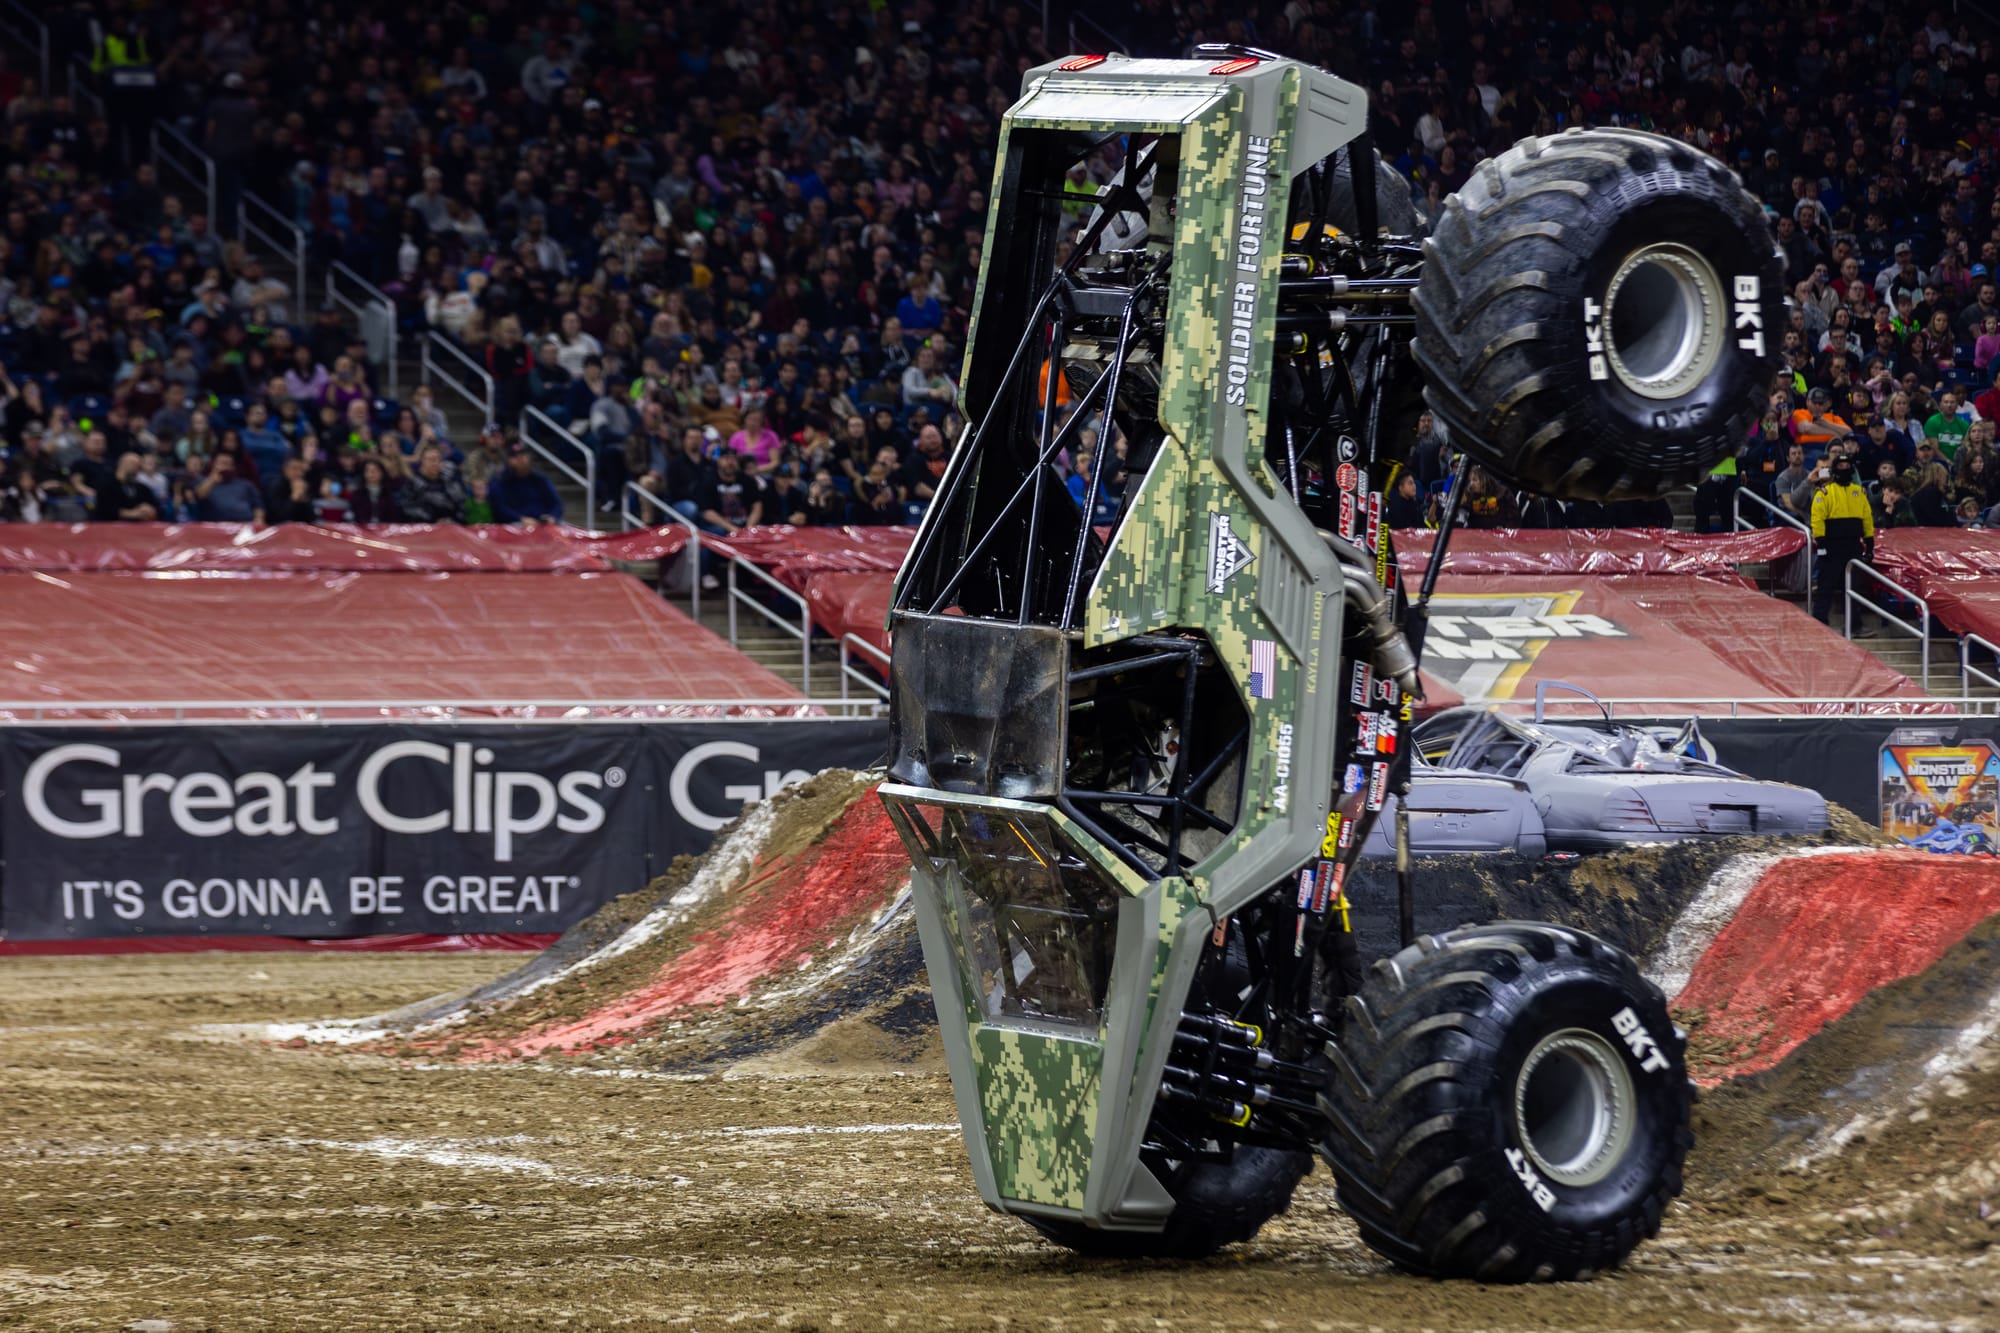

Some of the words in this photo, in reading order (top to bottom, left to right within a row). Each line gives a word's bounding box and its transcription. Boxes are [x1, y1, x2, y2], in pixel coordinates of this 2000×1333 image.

[1236, 134, 1270, 274] FORTUNE
[1583, 297, 1609, 380] BKT
[1734, 275, 1766, 357] BKT
[1225, 280, 1257, 407] SOLDIER
[1339, 494, 1350, 538] MSD
[1367, 494, 1379, 551] ARP
[1213, 514, 1231, 594] MONSTER
[1224, 537, 1237, 573] JAM
[1311, 590, 1323, 642] BLOOD
[1307, 647, 1319, 694] KAYLA
[1353, 664, 1366, 704] OPTIMA
[22, 743, 338, 838] Great
[1367, 769, 1380, 808] LINCOLN
[1908, 764, 1976, 775] MONSTER
[1926, 776, 1958, 786] JAM
[62, 880, 145, 921] IT'S
[162, 877, 332, 919] GONNA
[349, 876, 404, 914] BE
[1610, 1006, 1671, 1074] BKT
[1504, 1147, 1558, 1213] BKT
